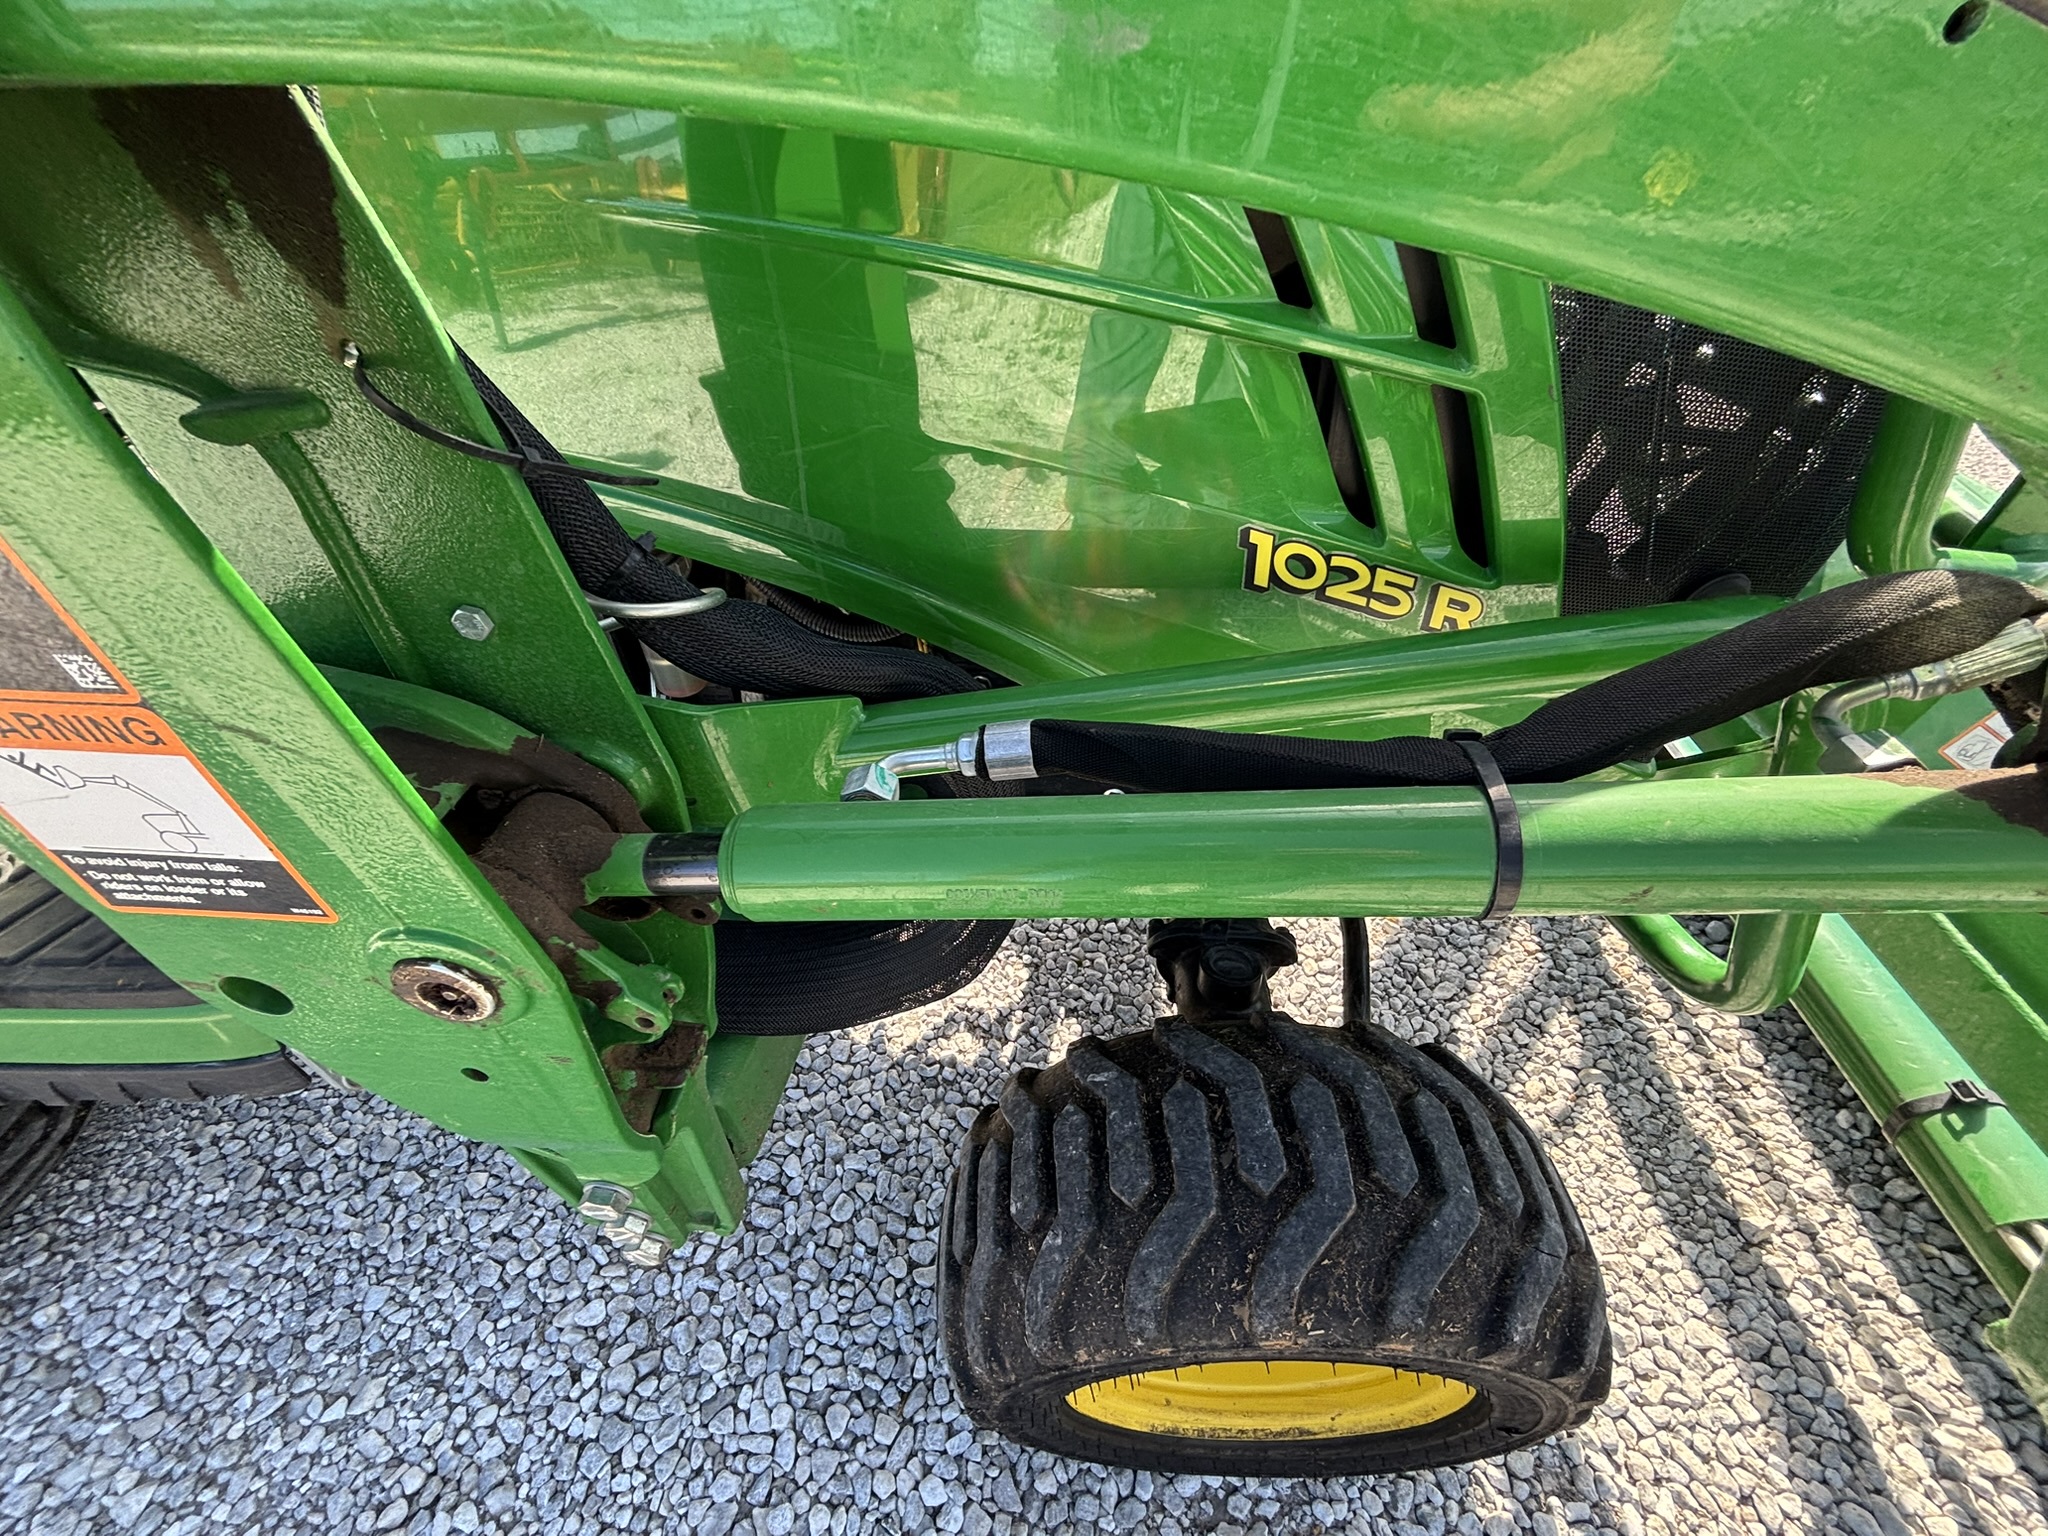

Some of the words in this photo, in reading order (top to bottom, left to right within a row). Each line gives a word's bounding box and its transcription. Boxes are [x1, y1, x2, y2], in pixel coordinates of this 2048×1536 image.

[1240, 526, 1418, 619] 1025
[1421, 583, 1484, 631] R
[62, 855, 86, 864] To
[85, 857, 127, 866] avoid
[124, 858, 169, 870] injury
[167, 860, 205, 870] from
[203, 862, 243, 872] falls:
[101, 881, 143, 891] riders
[143, 884, 164, 892] on
[161, 884, 208, 894] loader
[225, 887, 248, 896] its
[111, 873, 139, 881] not
[136, 875, 174, 883] work
[172, 875, 210, 885] from
[227, 878, 266, 888] allow
